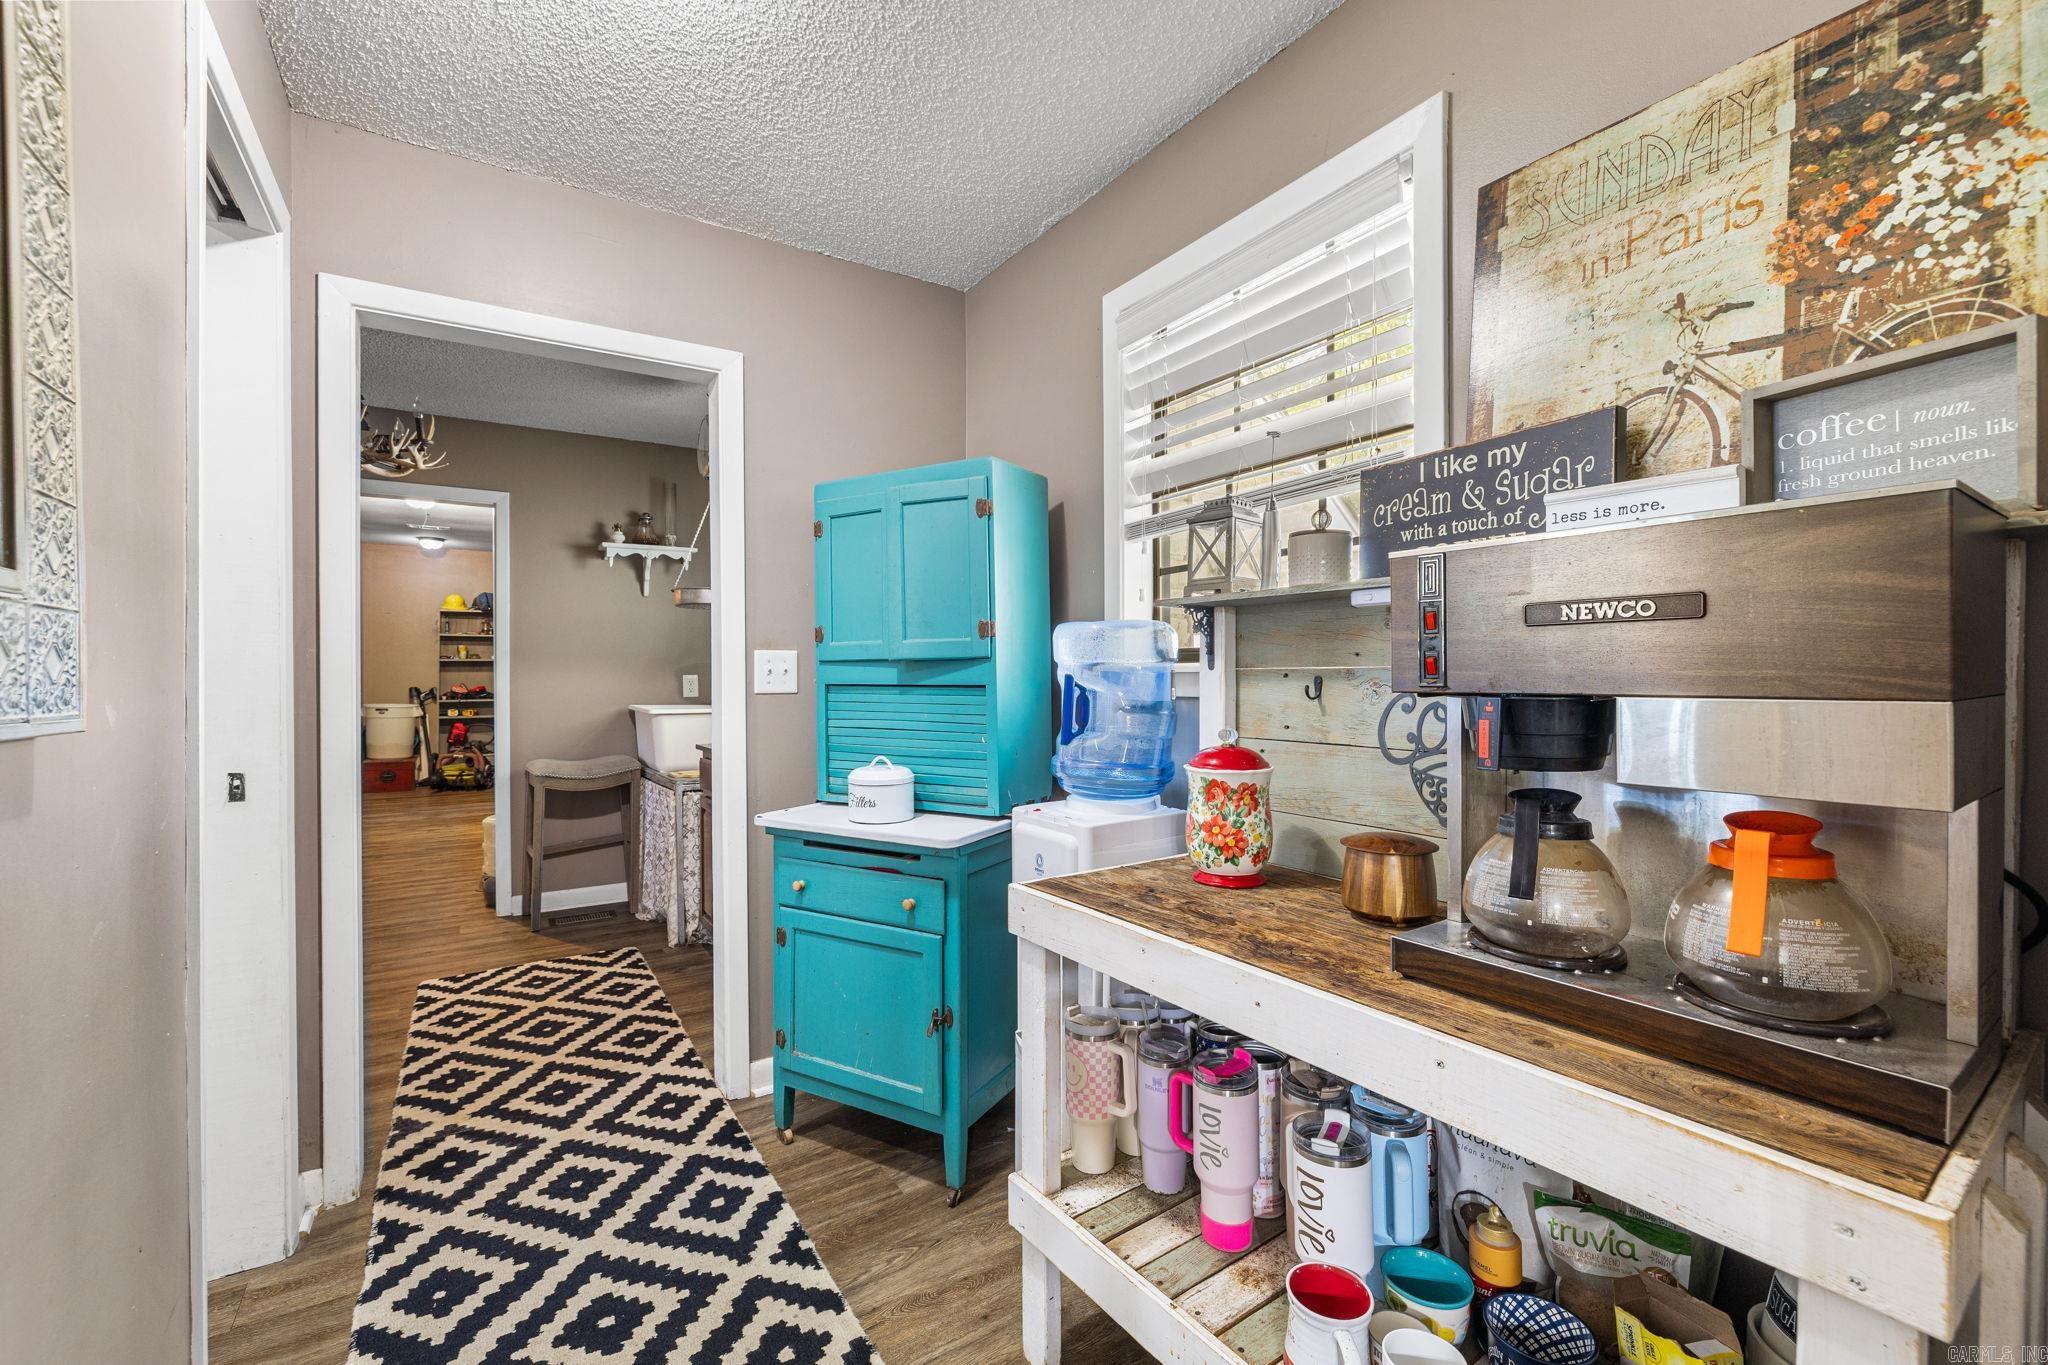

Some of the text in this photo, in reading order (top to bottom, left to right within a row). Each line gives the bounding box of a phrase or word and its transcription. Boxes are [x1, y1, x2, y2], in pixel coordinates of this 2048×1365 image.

[1519, 77, 1771, 249] SUNDAY
[1581, 185, 1765, 284] in Paris
[1777, 410, 1887, 451] coffee
[1912, 400, 1977, 424] noun.
[1779, 417, 2018, 474] 1. liquid that smells lik
[1419, 441, 1528, 483] I like my
[1373, 455, 1596, 528] cream & Sugar
[1551, 500, 1666, 525] less is more.
[1400, 522, 1434, 543] with
[1437, 525, 1448, 536] a
[1451, 512, 1499, 535] touch
[1503, 505, 1526, 525] of
[1560, 599, 1657, 621] NEWCO
[1702, 902, 1729, 913] WARNIN
[1456, 1143, 1477, 1156] clean
[1488, 1156, 1515, 1172] simple
[1769, 1288, 1797, 1333] SUGA
